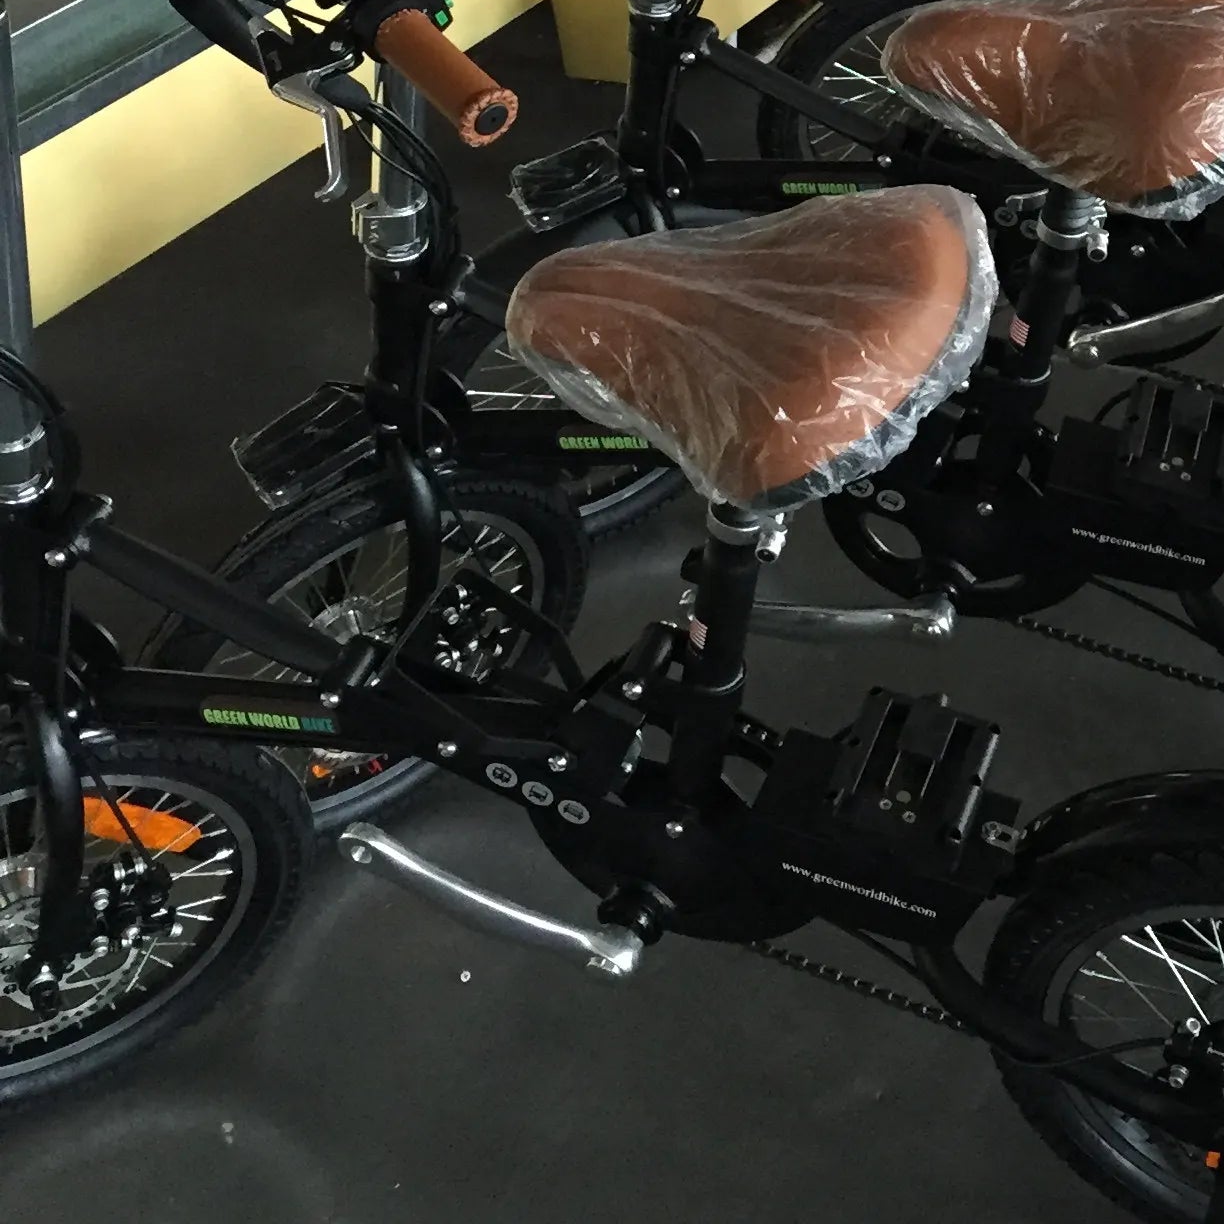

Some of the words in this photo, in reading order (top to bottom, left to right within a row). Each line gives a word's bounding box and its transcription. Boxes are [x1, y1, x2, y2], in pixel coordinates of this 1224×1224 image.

[782, 182, 817, 195] GREEN
[559, 436, 600, 449] GREEN
[1072, 527, 1206, 566] www.greenworldbike.com
[203, 708, 248, 726] GREEN
[247, 712, 300, 730] WORLD
[782, 862, 937, 918] www.greenworldbike.com
